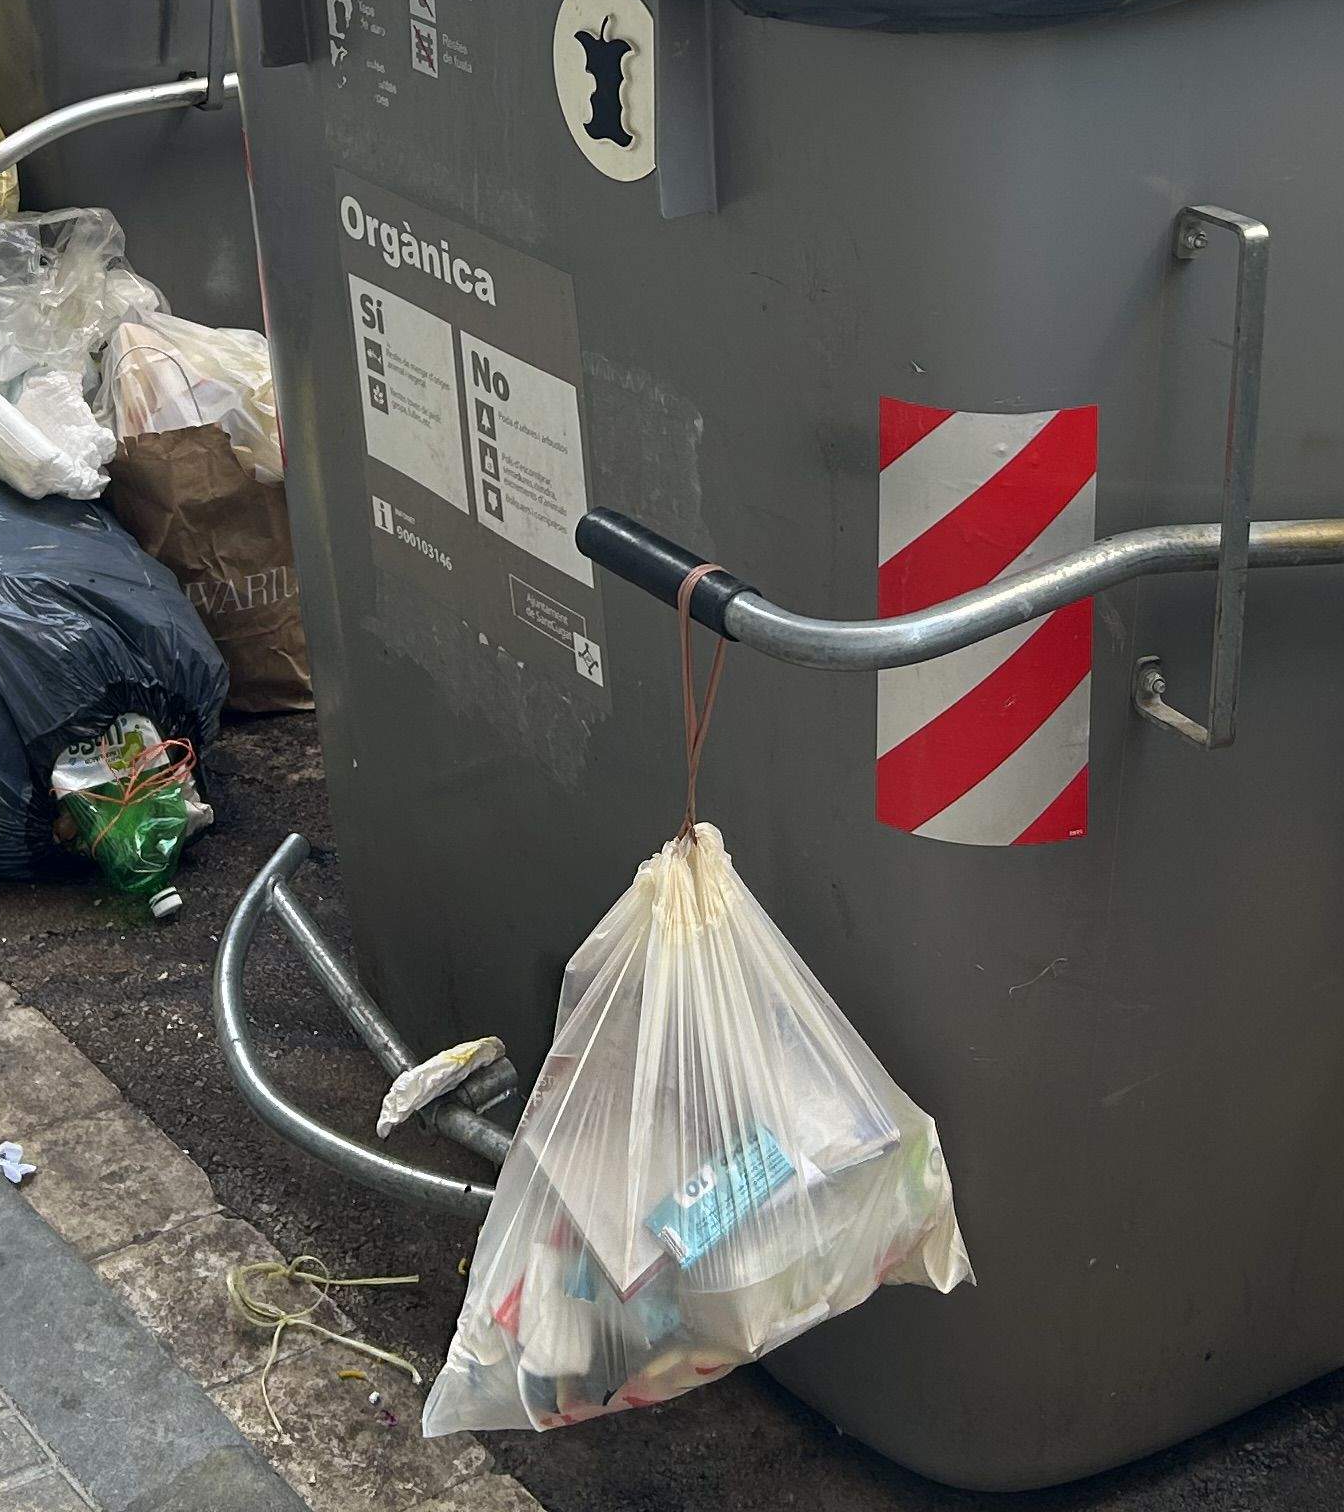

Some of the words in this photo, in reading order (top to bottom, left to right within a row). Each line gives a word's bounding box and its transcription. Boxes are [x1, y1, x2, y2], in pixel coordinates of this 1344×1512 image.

[340, 195, 497, 307] Orgànica
[471, 350, 510, 402] No
[396, 525, 453, 571] 900103146
